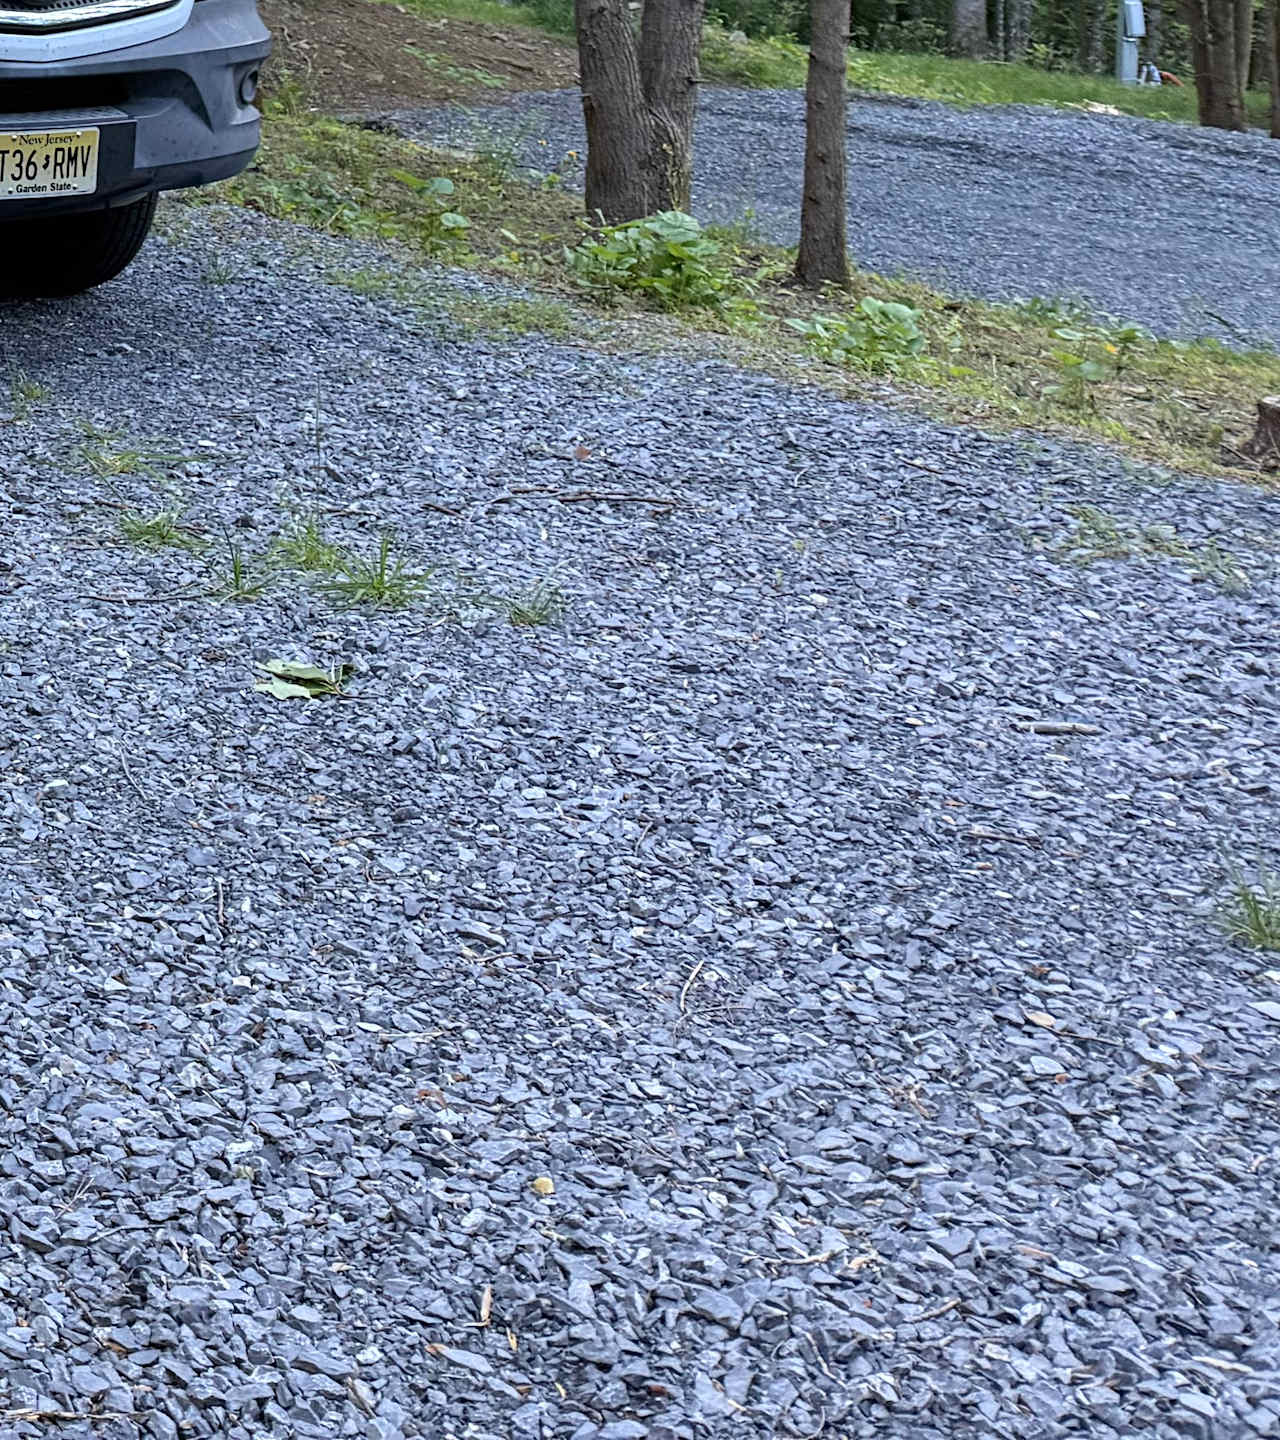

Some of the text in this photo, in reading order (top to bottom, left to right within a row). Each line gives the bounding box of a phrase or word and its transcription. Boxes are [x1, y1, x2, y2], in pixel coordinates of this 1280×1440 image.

[18, 133, 74, 147] New Jersey
[15, 182, 72, 194] Garden State
